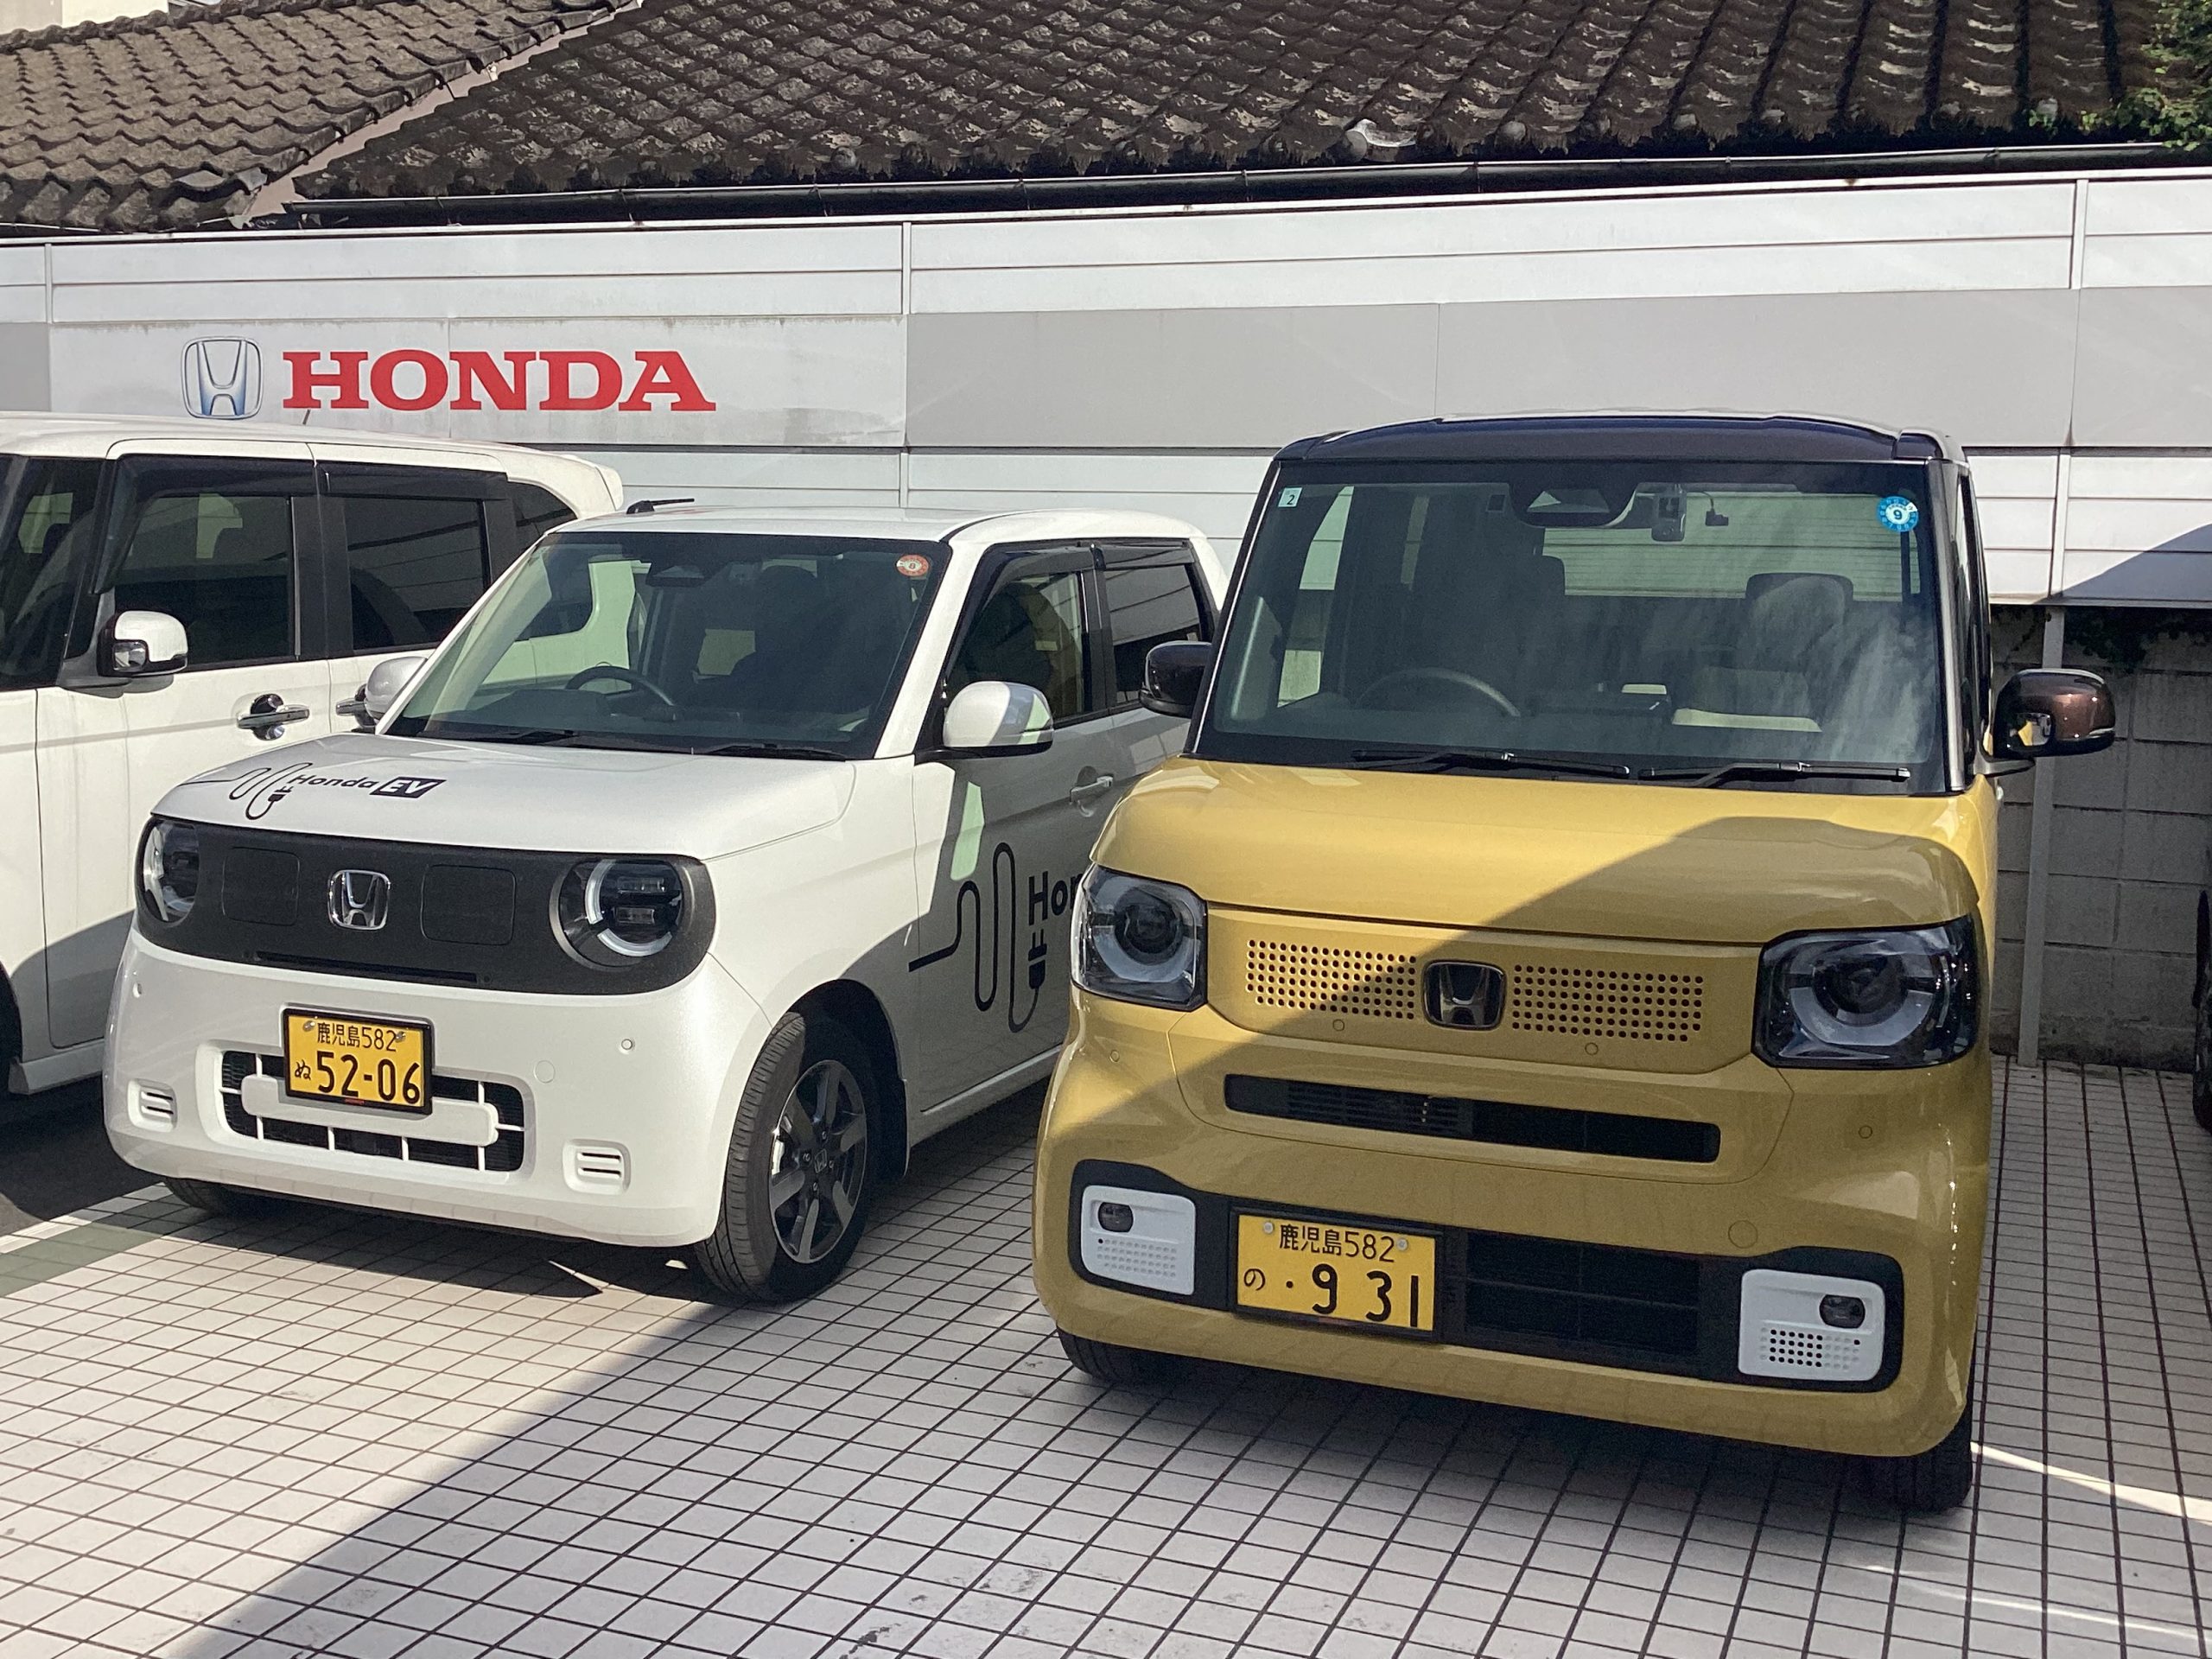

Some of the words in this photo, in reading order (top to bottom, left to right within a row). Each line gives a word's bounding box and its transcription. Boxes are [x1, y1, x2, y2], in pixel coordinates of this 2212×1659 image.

[283, 348, 716, 412] HONDA
[1287, 494, 1295, 505] 2
[1893, 509, 1903, 520] 9
[286, 774, 379, 789] Honda
[379, 779, 438, 794] EV
[316, 1050, 421, 1104] 52-06
[1243, 1268, 1266, 1291] の
